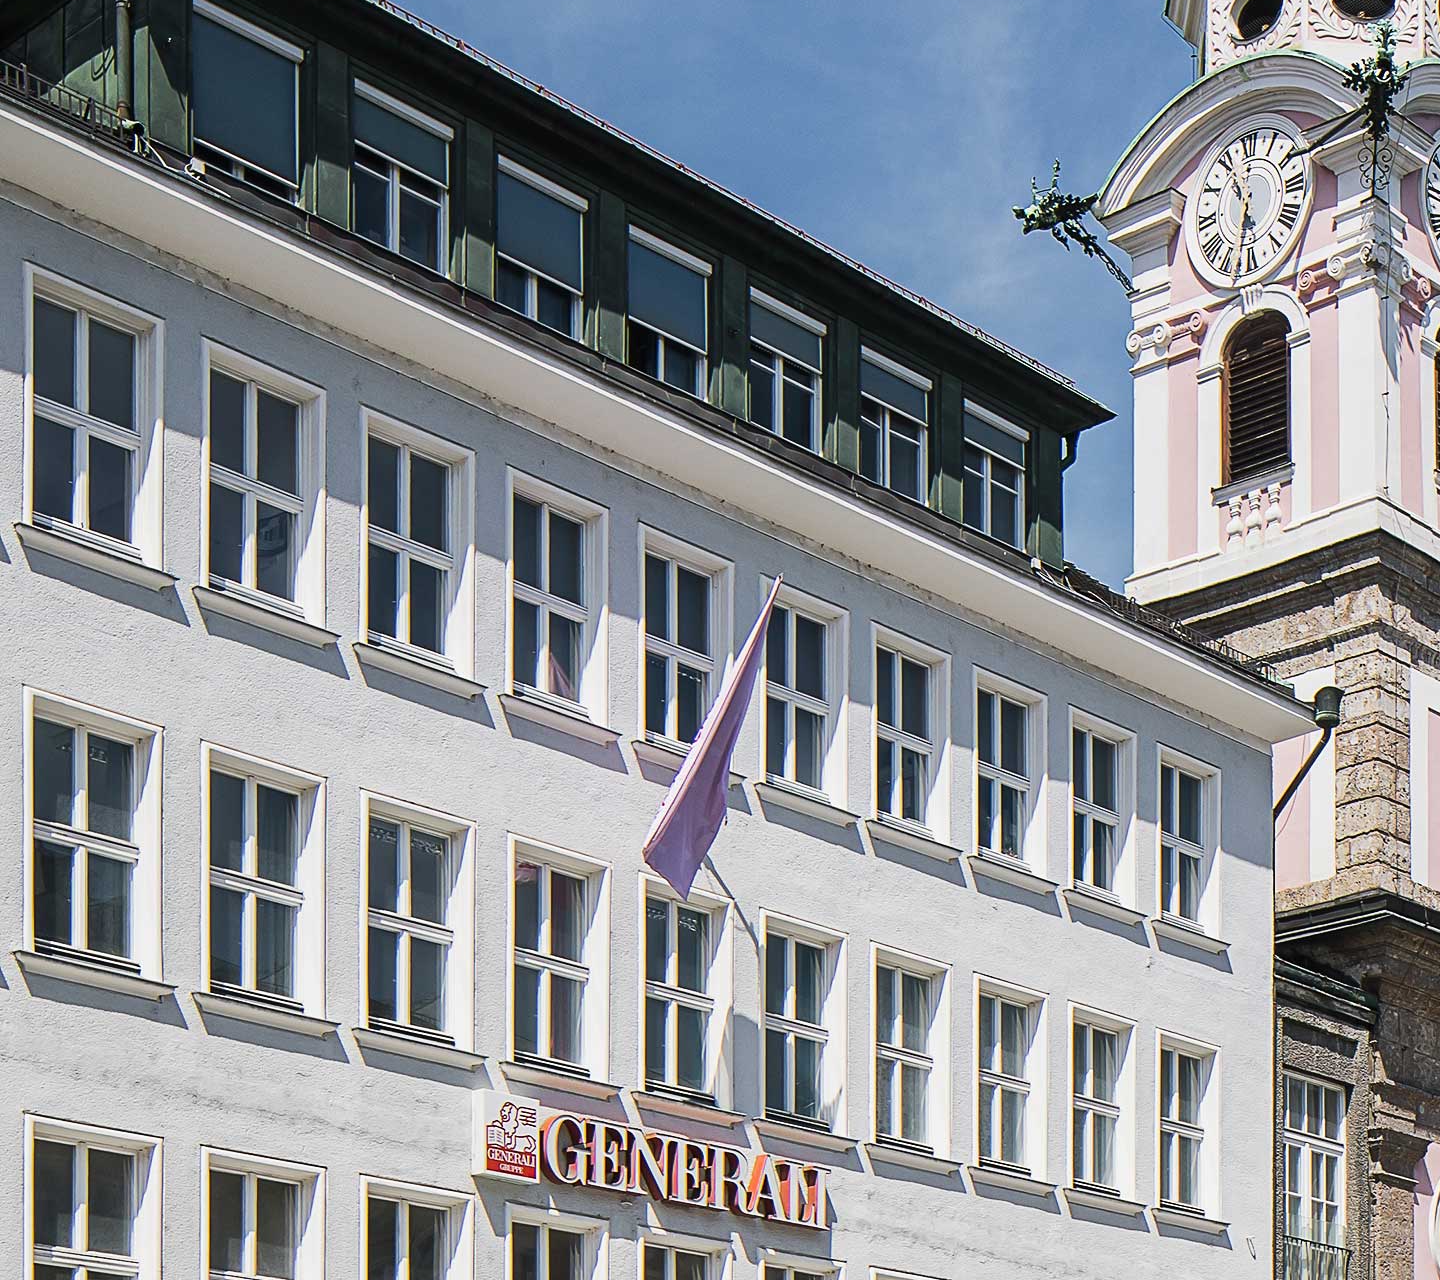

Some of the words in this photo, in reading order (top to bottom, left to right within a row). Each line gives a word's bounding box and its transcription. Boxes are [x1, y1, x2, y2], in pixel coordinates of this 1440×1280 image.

[487, 1147, 536, 1167] GENERALI
[499, 1163, 525, 1174] GRUPPE
[541, 1114, 833, 1231] GENERALI
